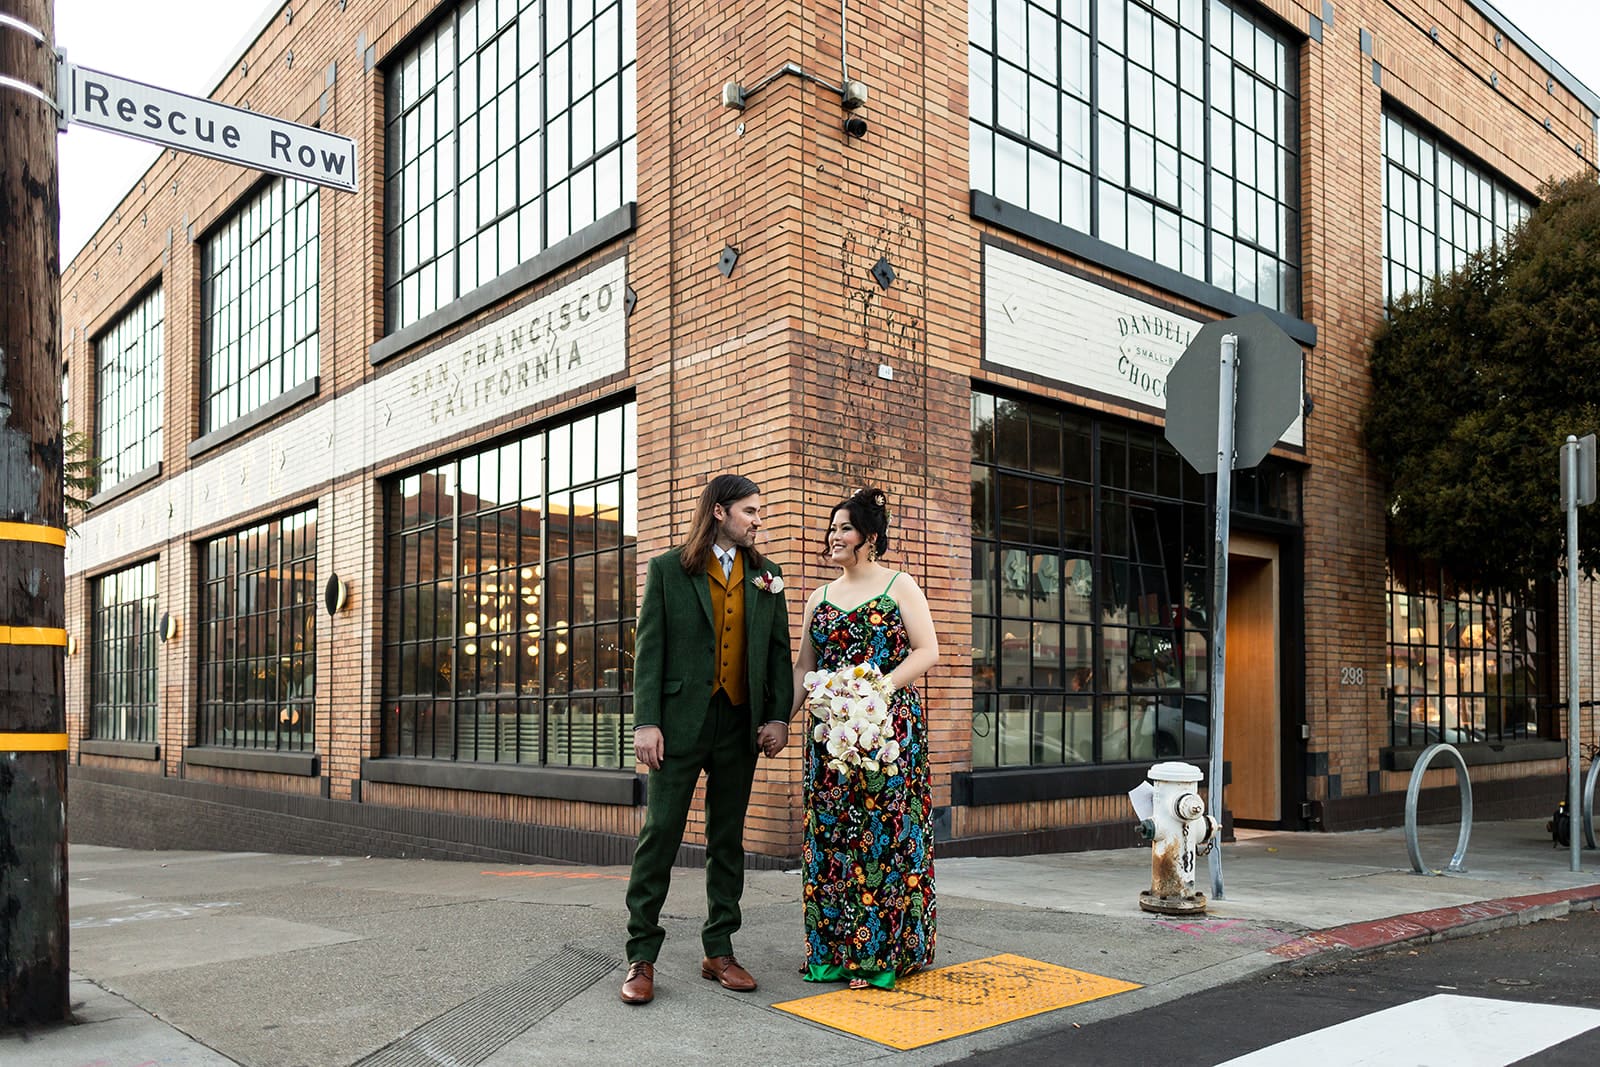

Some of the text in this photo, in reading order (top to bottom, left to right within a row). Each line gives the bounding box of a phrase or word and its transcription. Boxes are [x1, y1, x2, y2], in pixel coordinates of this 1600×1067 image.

[84, 81, 346, 175] Rescue Row
[410, 283, 613, 397] SAN FRANCISCO
[429, 339, 582, 424] CALIFORNIA
[1341, 667, 1364, 685] 298
